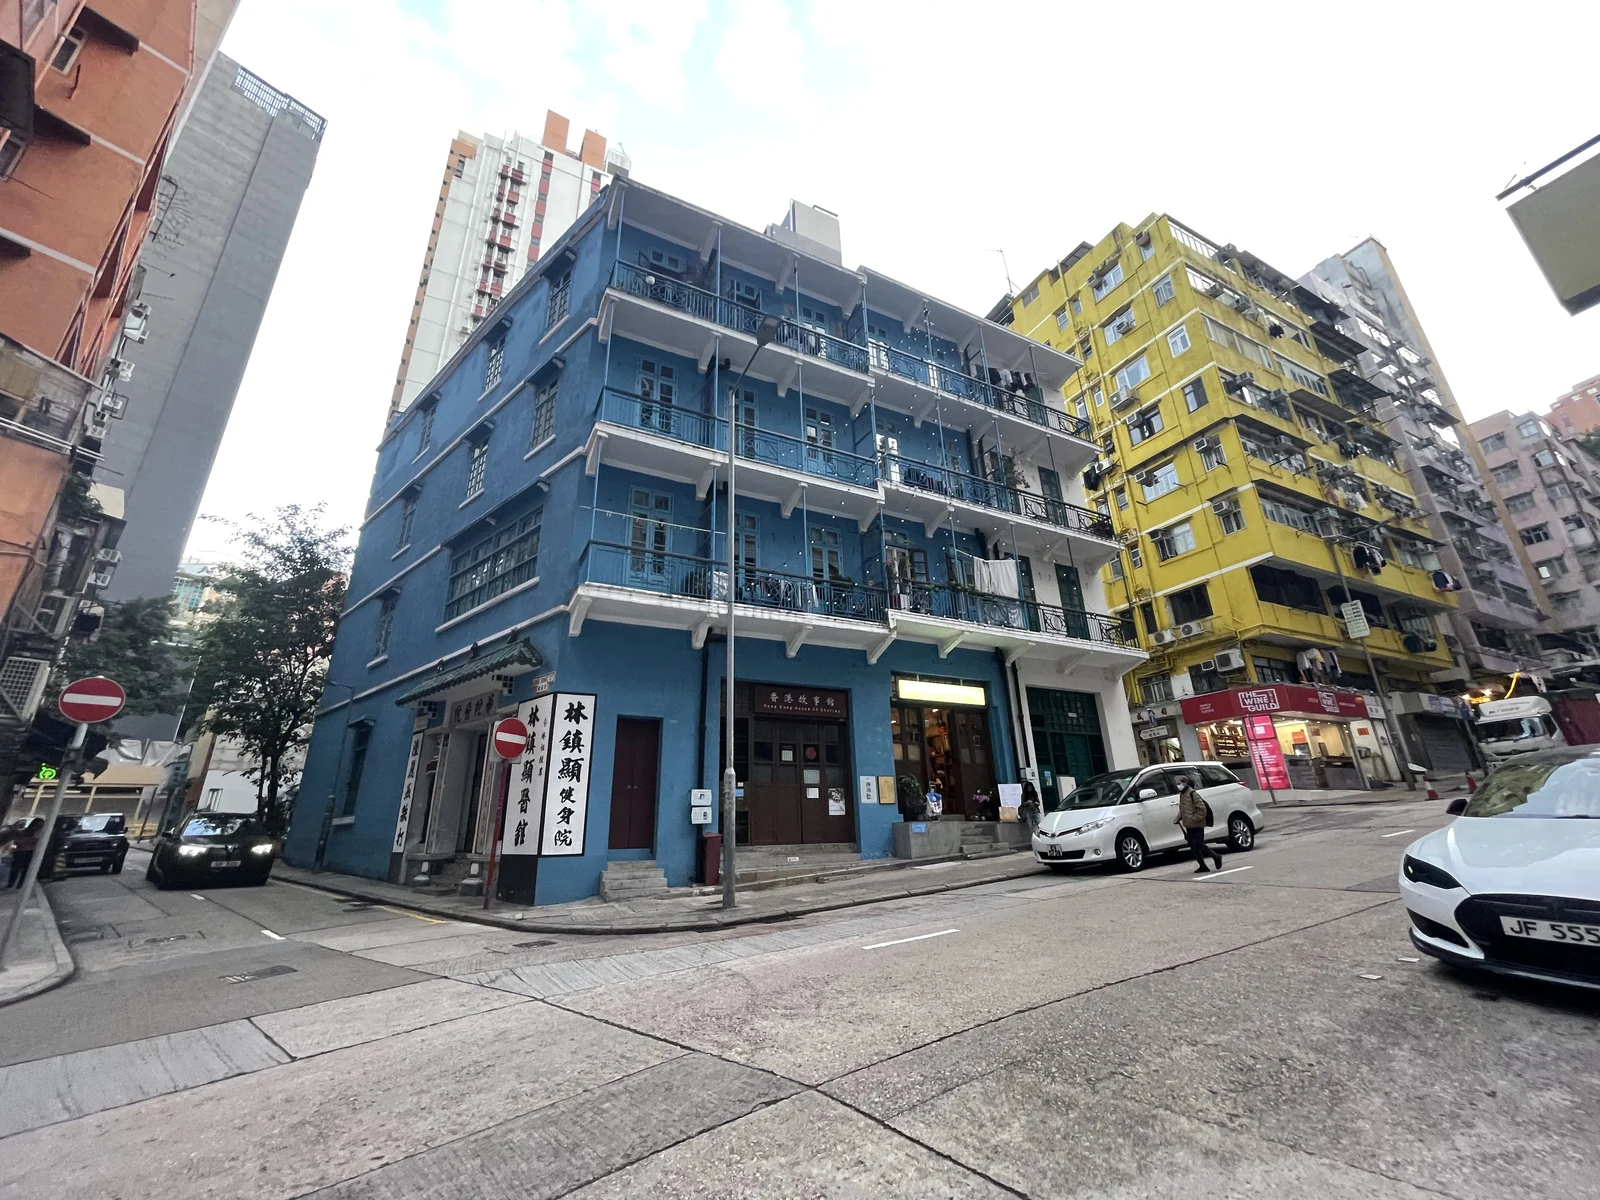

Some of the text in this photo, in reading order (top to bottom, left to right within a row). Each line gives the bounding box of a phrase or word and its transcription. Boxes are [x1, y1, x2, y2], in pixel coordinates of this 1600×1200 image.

[770, 692, 835, 706] 香港故事館
[1240, 691, 1257, 699] THE
[1244, 697, 1269, 705] WINE
[1248, 703, 1278, 712] GUILD
[554, 700, 588, 847] 林鎮顯健身院
[1510, 920, 1537, 936] JF
